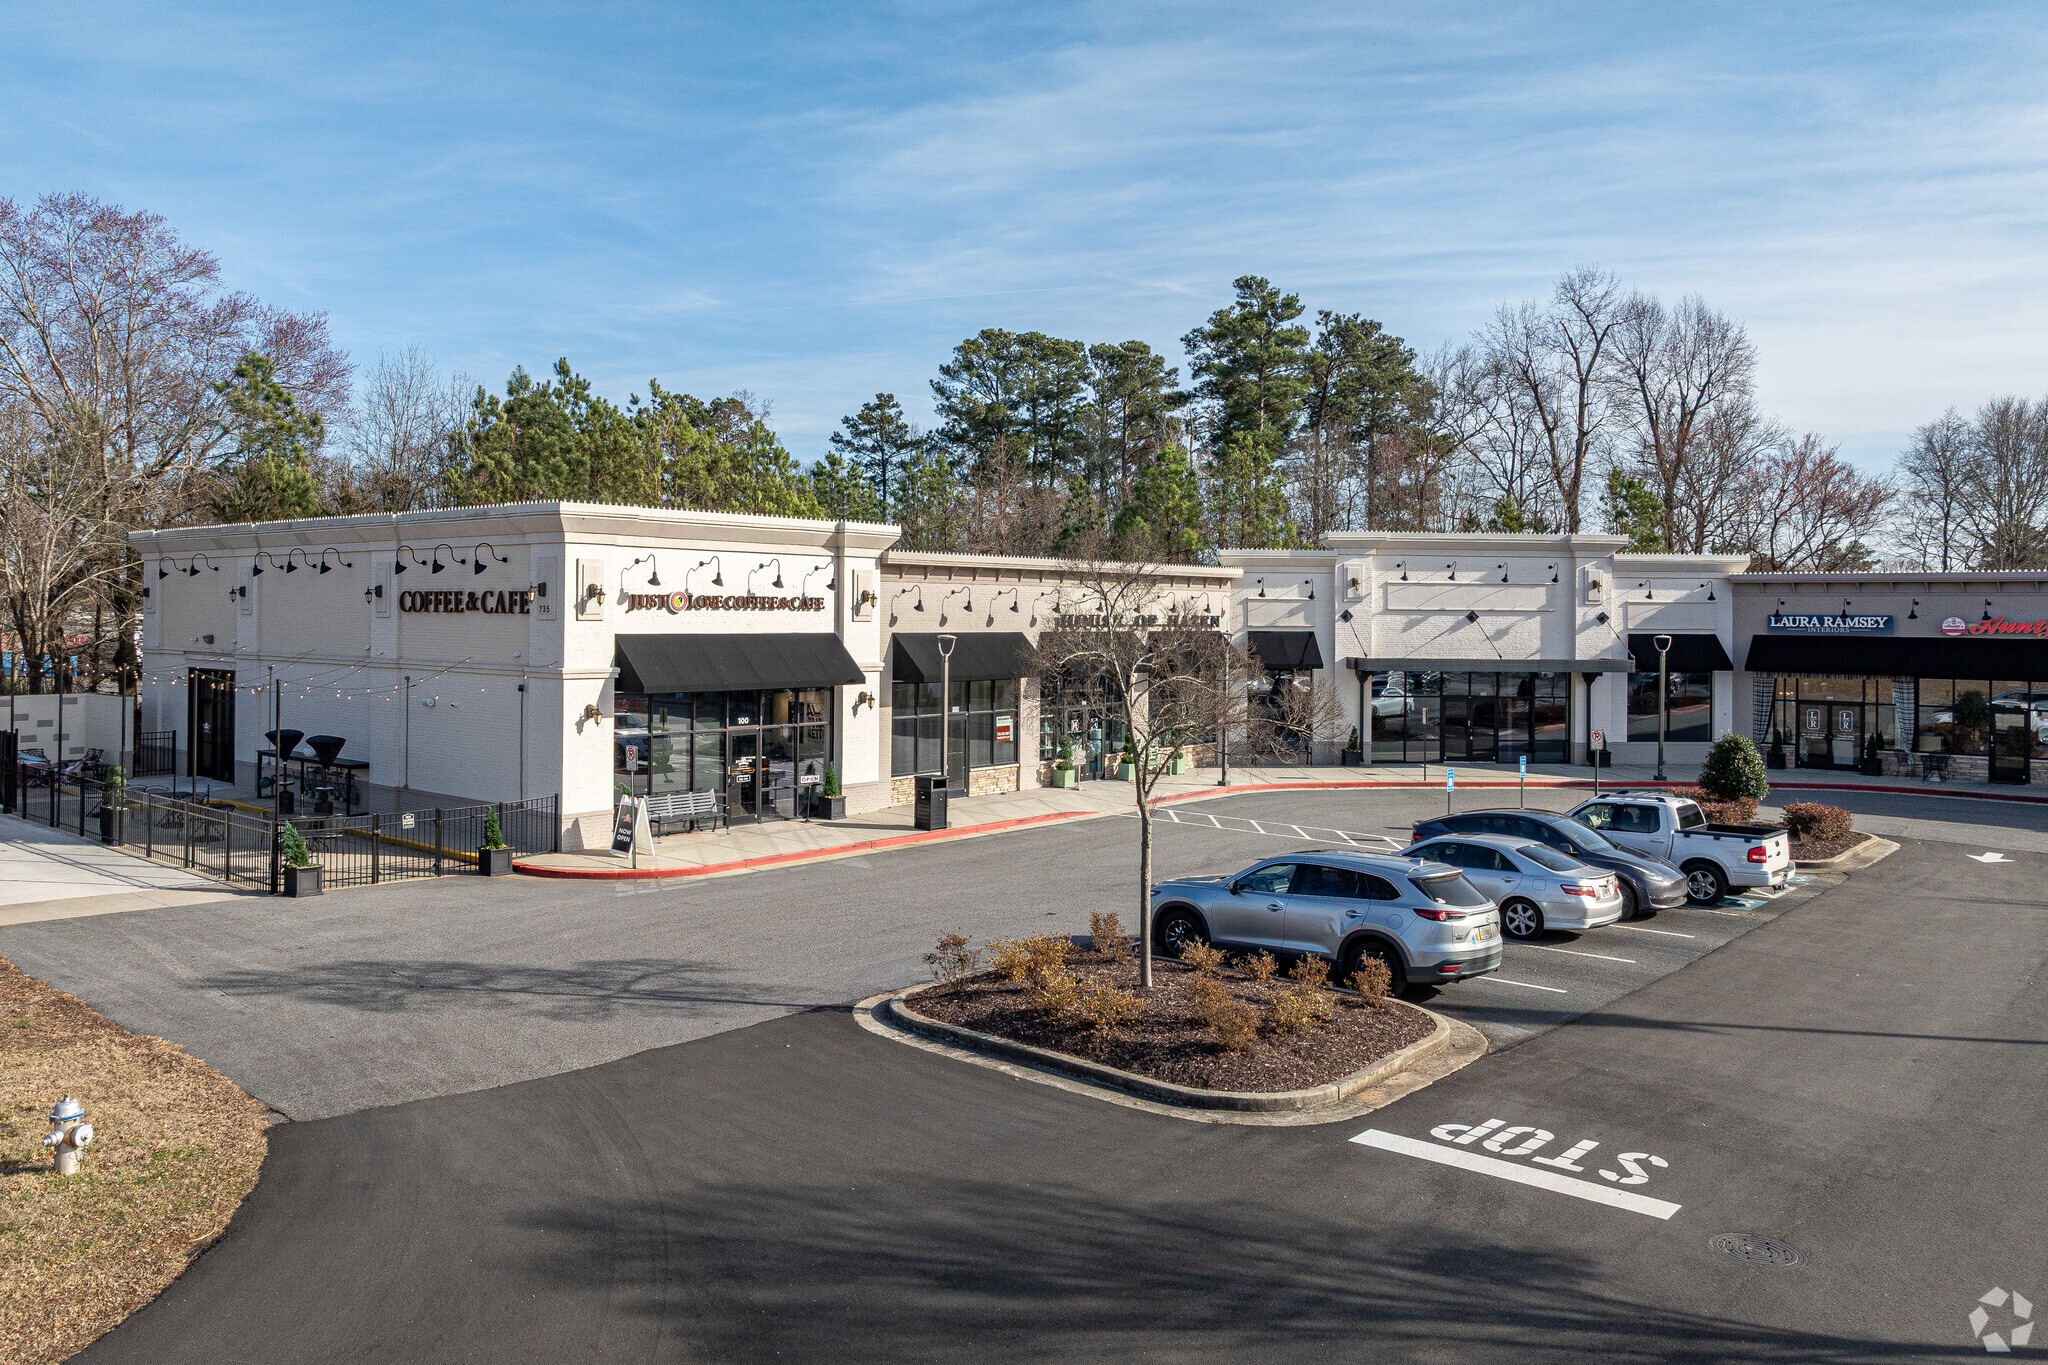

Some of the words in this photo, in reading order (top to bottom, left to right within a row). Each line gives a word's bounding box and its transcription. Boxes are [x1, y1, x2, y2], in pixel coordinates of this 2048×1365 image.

[626, 594, 669, 612] JUST
[687, 594, 723, 610] LOVE
[539, 605, 550, 613] 735
[1770, 616, 1821, 627] LAURA
[1823, 616, 1888, 628] RAMSEY
[619, 828, 632, 836] NOW
[616, 834, 631, 843] OPEN
[1430, 1118, 1669, 1185] STOP
